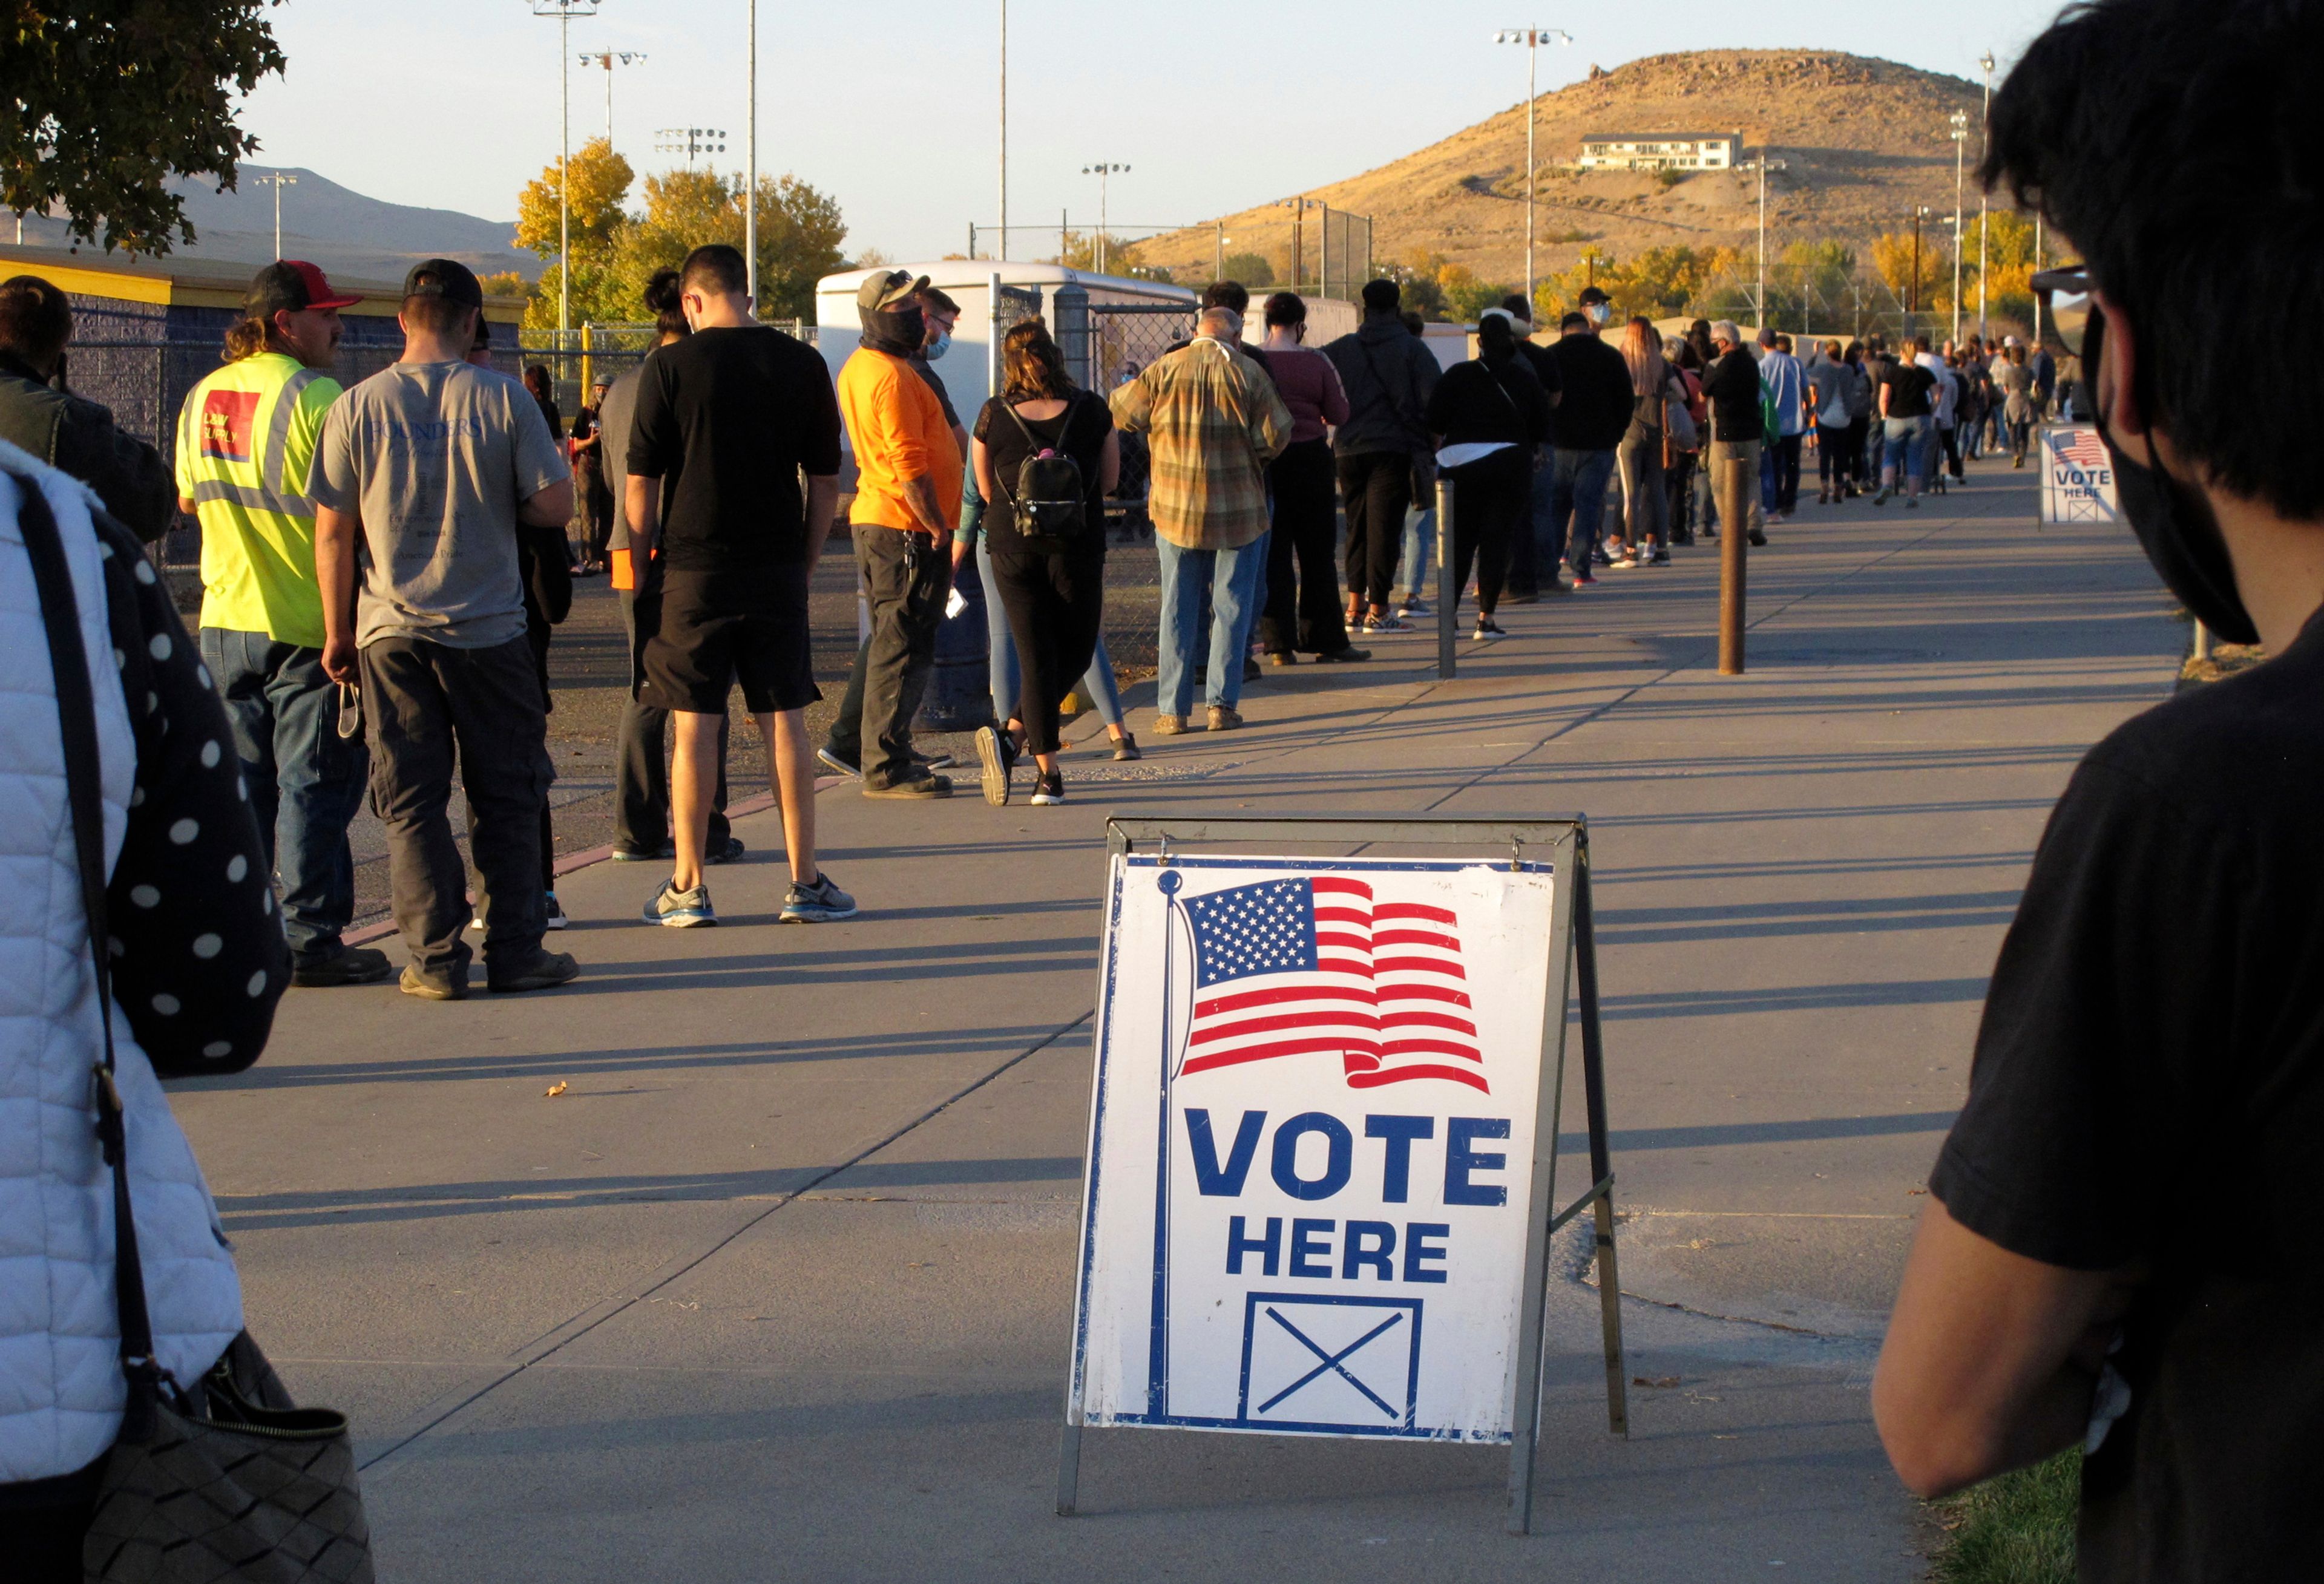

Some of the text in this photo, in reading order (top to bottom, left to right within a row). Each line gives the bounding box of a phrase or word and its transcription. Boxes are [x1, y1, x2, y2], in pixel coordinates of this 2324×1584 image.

[204, 412, 229, 426] L&W
[205, 427, 237, 443] SUPPLY
[2056, 470, 2110, 485] VOTE
[2064, 488, 2101, 497] HERE
[1184, 1108, 1511, 1206] VOTE
[1226, 1216, 1450, 1283] HERE
